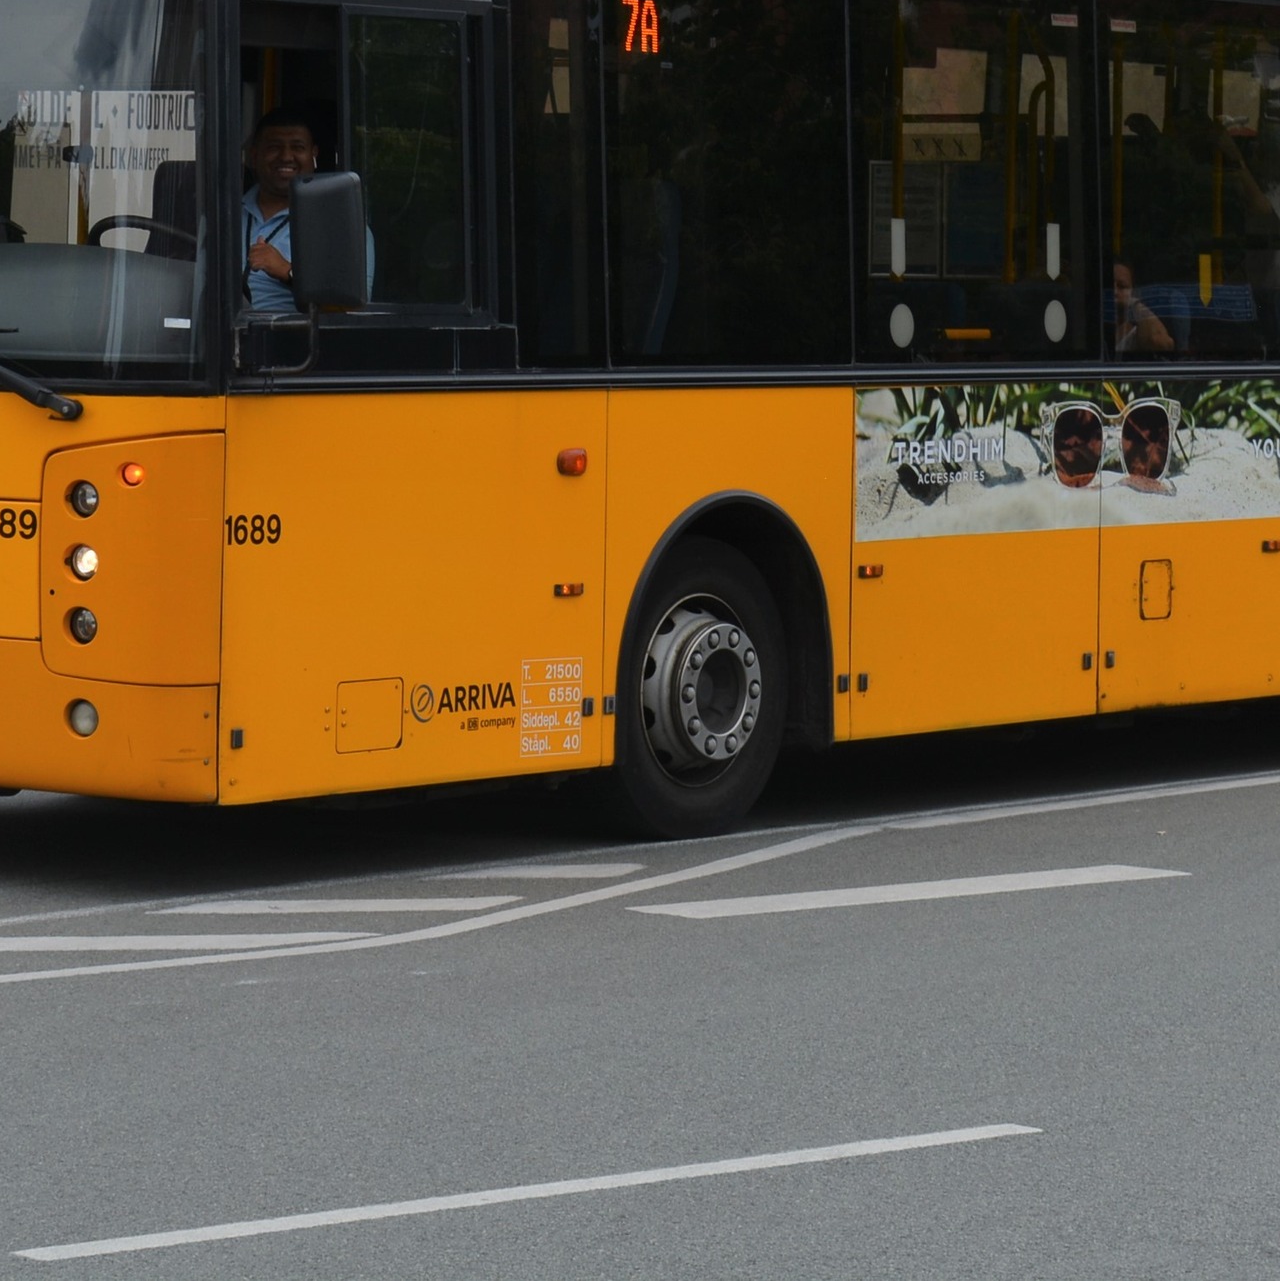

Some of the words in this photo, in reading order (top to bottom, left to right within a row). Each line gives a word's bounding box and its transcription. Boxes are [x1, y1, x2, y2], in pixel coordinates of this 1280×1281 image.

[893, 437, 1005, 465] TRENDHIM
[917, 469, 986, 485] ACCESSORIES
[225, 513, 282, 546] 1689
[523, 664, 532, 680] T.
[545, 663, 581, 680] 21500
[437, 681, 516, 714] ARRIVA
[523, 688, 532, 704] L.
[548, 686, 581, 703] 6550
[480, 716, 516, 730] company
[521, 712, 560, 732] Siddepl.
[564, 710, 581, 726] 42
[521, 734, 551, 754] Ståpl.
[563, 734, 579, 750] 40
